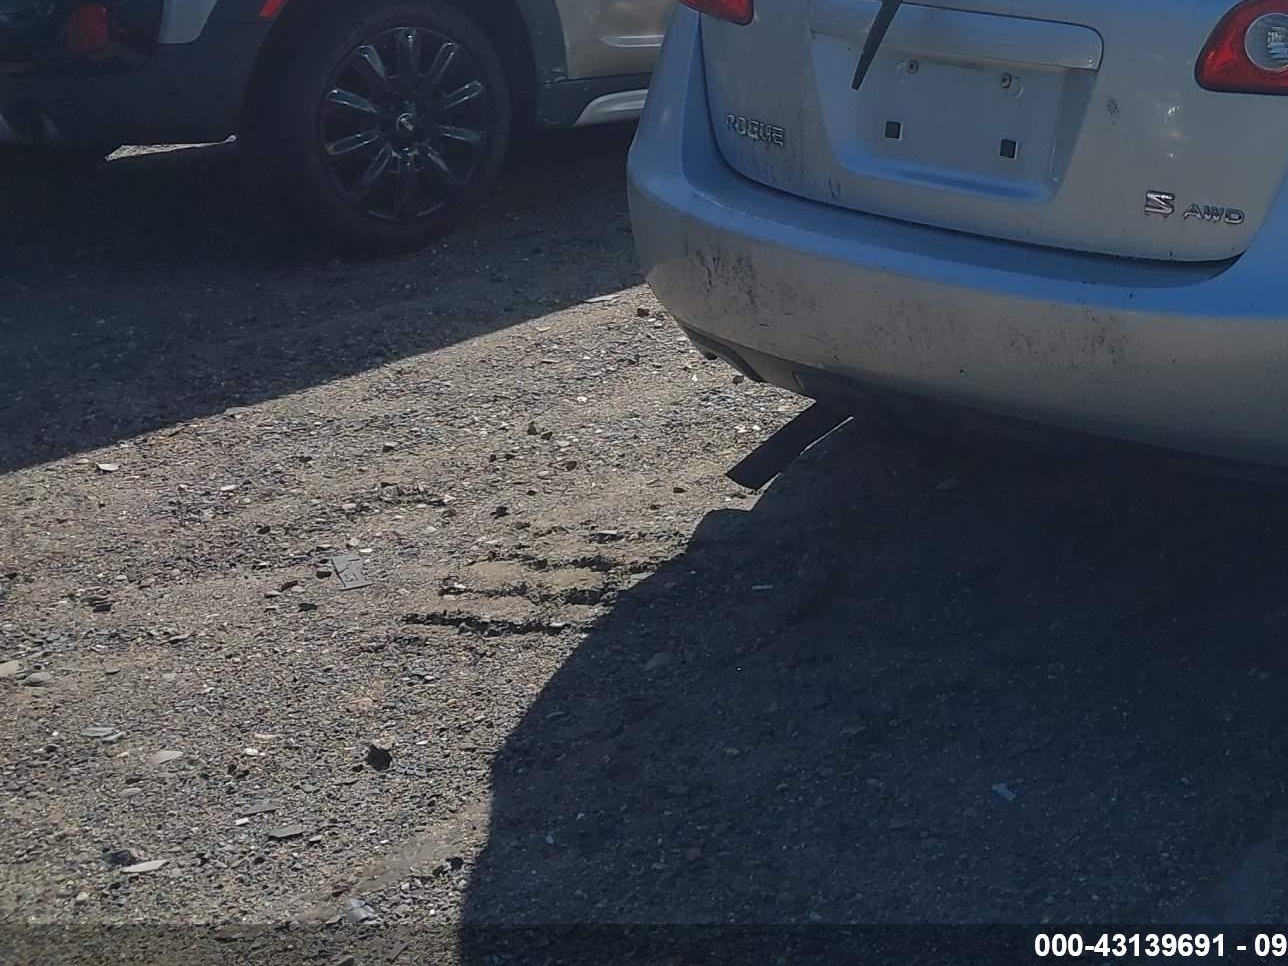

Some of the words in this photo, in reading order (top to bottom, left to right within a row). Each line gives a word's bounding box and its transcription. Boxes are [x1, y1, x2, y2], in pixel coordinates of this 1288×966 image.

[725, 113, 785, 147] ROGUE
[1144, 190, 1175, 216] S
[1183, 203, 1245, 225] AWD
